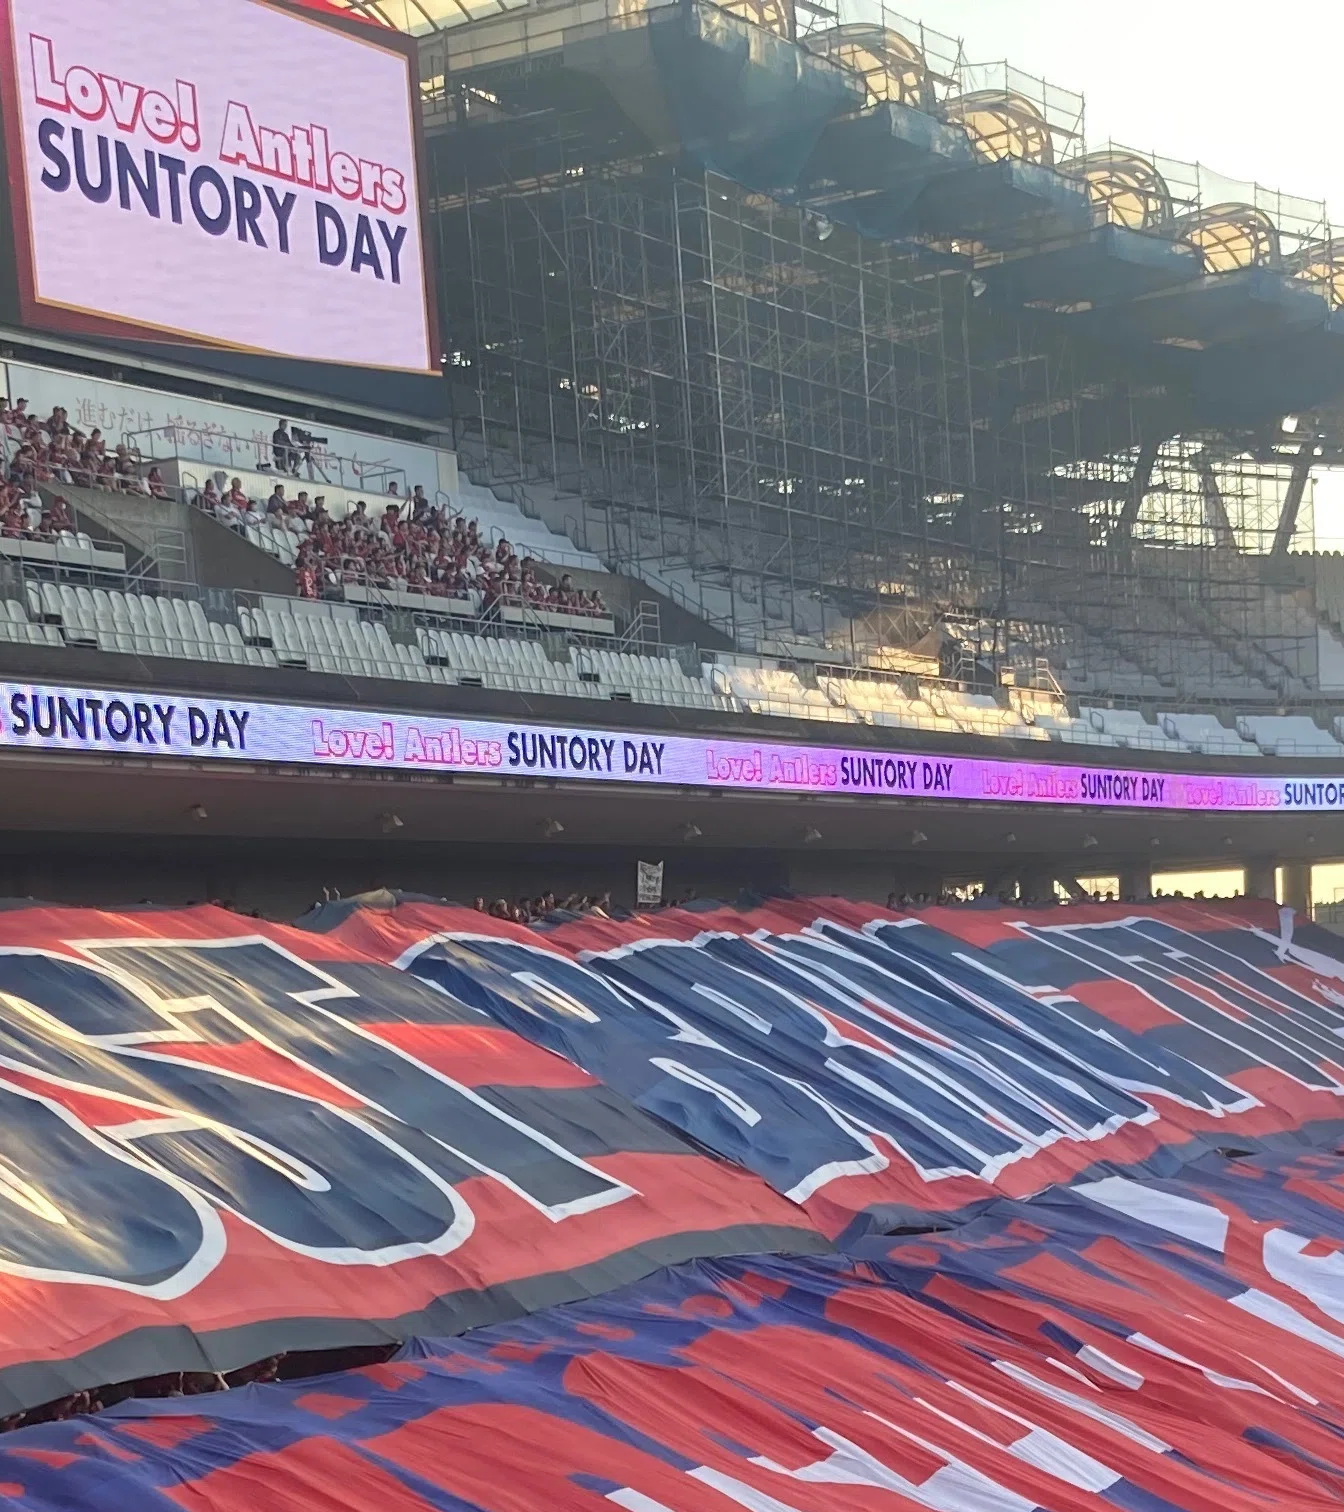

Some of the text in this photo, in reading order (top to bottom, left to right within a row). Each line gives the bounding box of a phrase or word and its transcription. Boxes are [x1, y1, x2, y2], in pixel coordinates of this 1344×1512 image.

[29, 33, 407, 215] Love! Antlers
[37, 118, 408, 285] SUNTORY DAY
[11, 692, 176, 746] SUNTORY
[188, 706, 250, 750] DAY
[312, 720, 666, 776] Love! Antlers SUNTORY DAY
[840, 755, 918, 790] SUNTORY
[922, 762, 954, 792] DAY
[1080, 772, 1139, 802] SUNTORY
[1141, 776, 1166, 803] DAY
[389, 917, 1262, 1204] BRING
